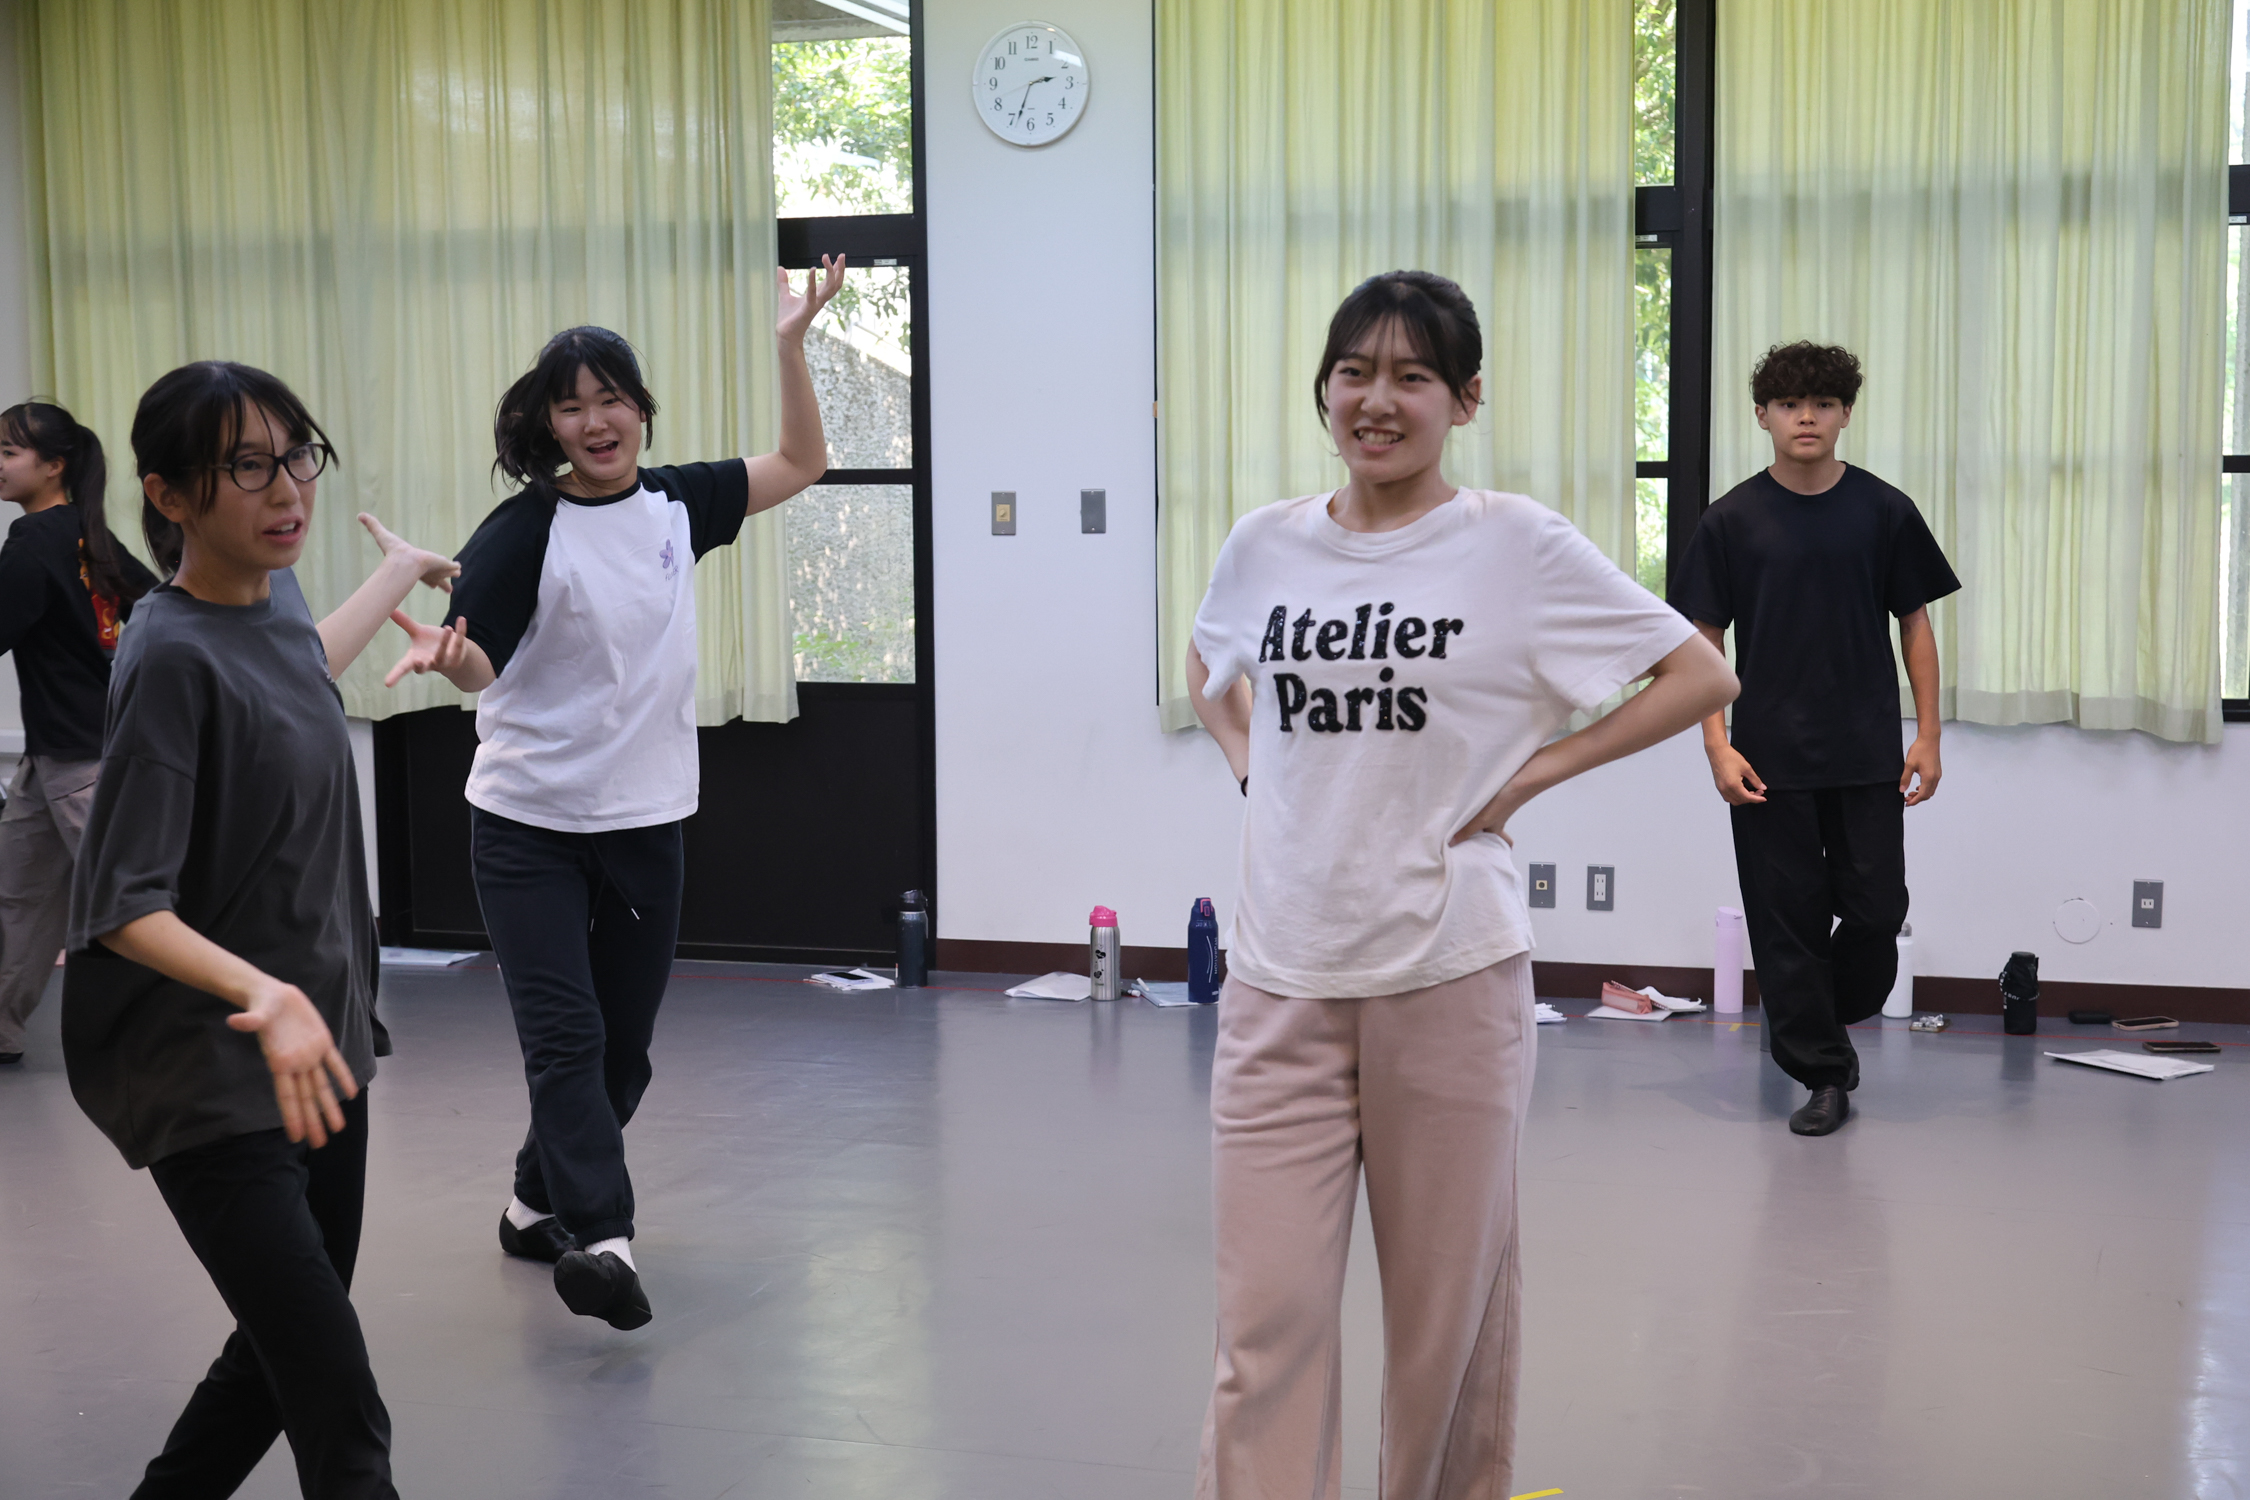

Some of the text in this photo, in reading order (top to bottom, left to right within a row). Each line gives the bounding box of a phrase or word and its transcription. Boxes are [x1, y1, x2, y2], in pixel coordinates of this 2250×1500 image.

[1008, 41, 1017, 55] 11
[1026, 35, 1039, 49] 12
[1048, 40, 1053, 54] 1
[994, 56, 1006, 70] 10
[1061, 57, 1069, 69] 2
[989, 76, 998, 90] 9
[1065, 75, 1074, 90] 3
[993, 97, 1003, 111] 8
[1057, 96, 1066, 110] 4
[1008, 112, 1016, 126] 7
[1026, 117, 1035, 131] 6
[1046, 112, 1054, 126] 5
[1258, 601, 1464, 663] Atelier
[1273, 666, 1428, 733] Paris
